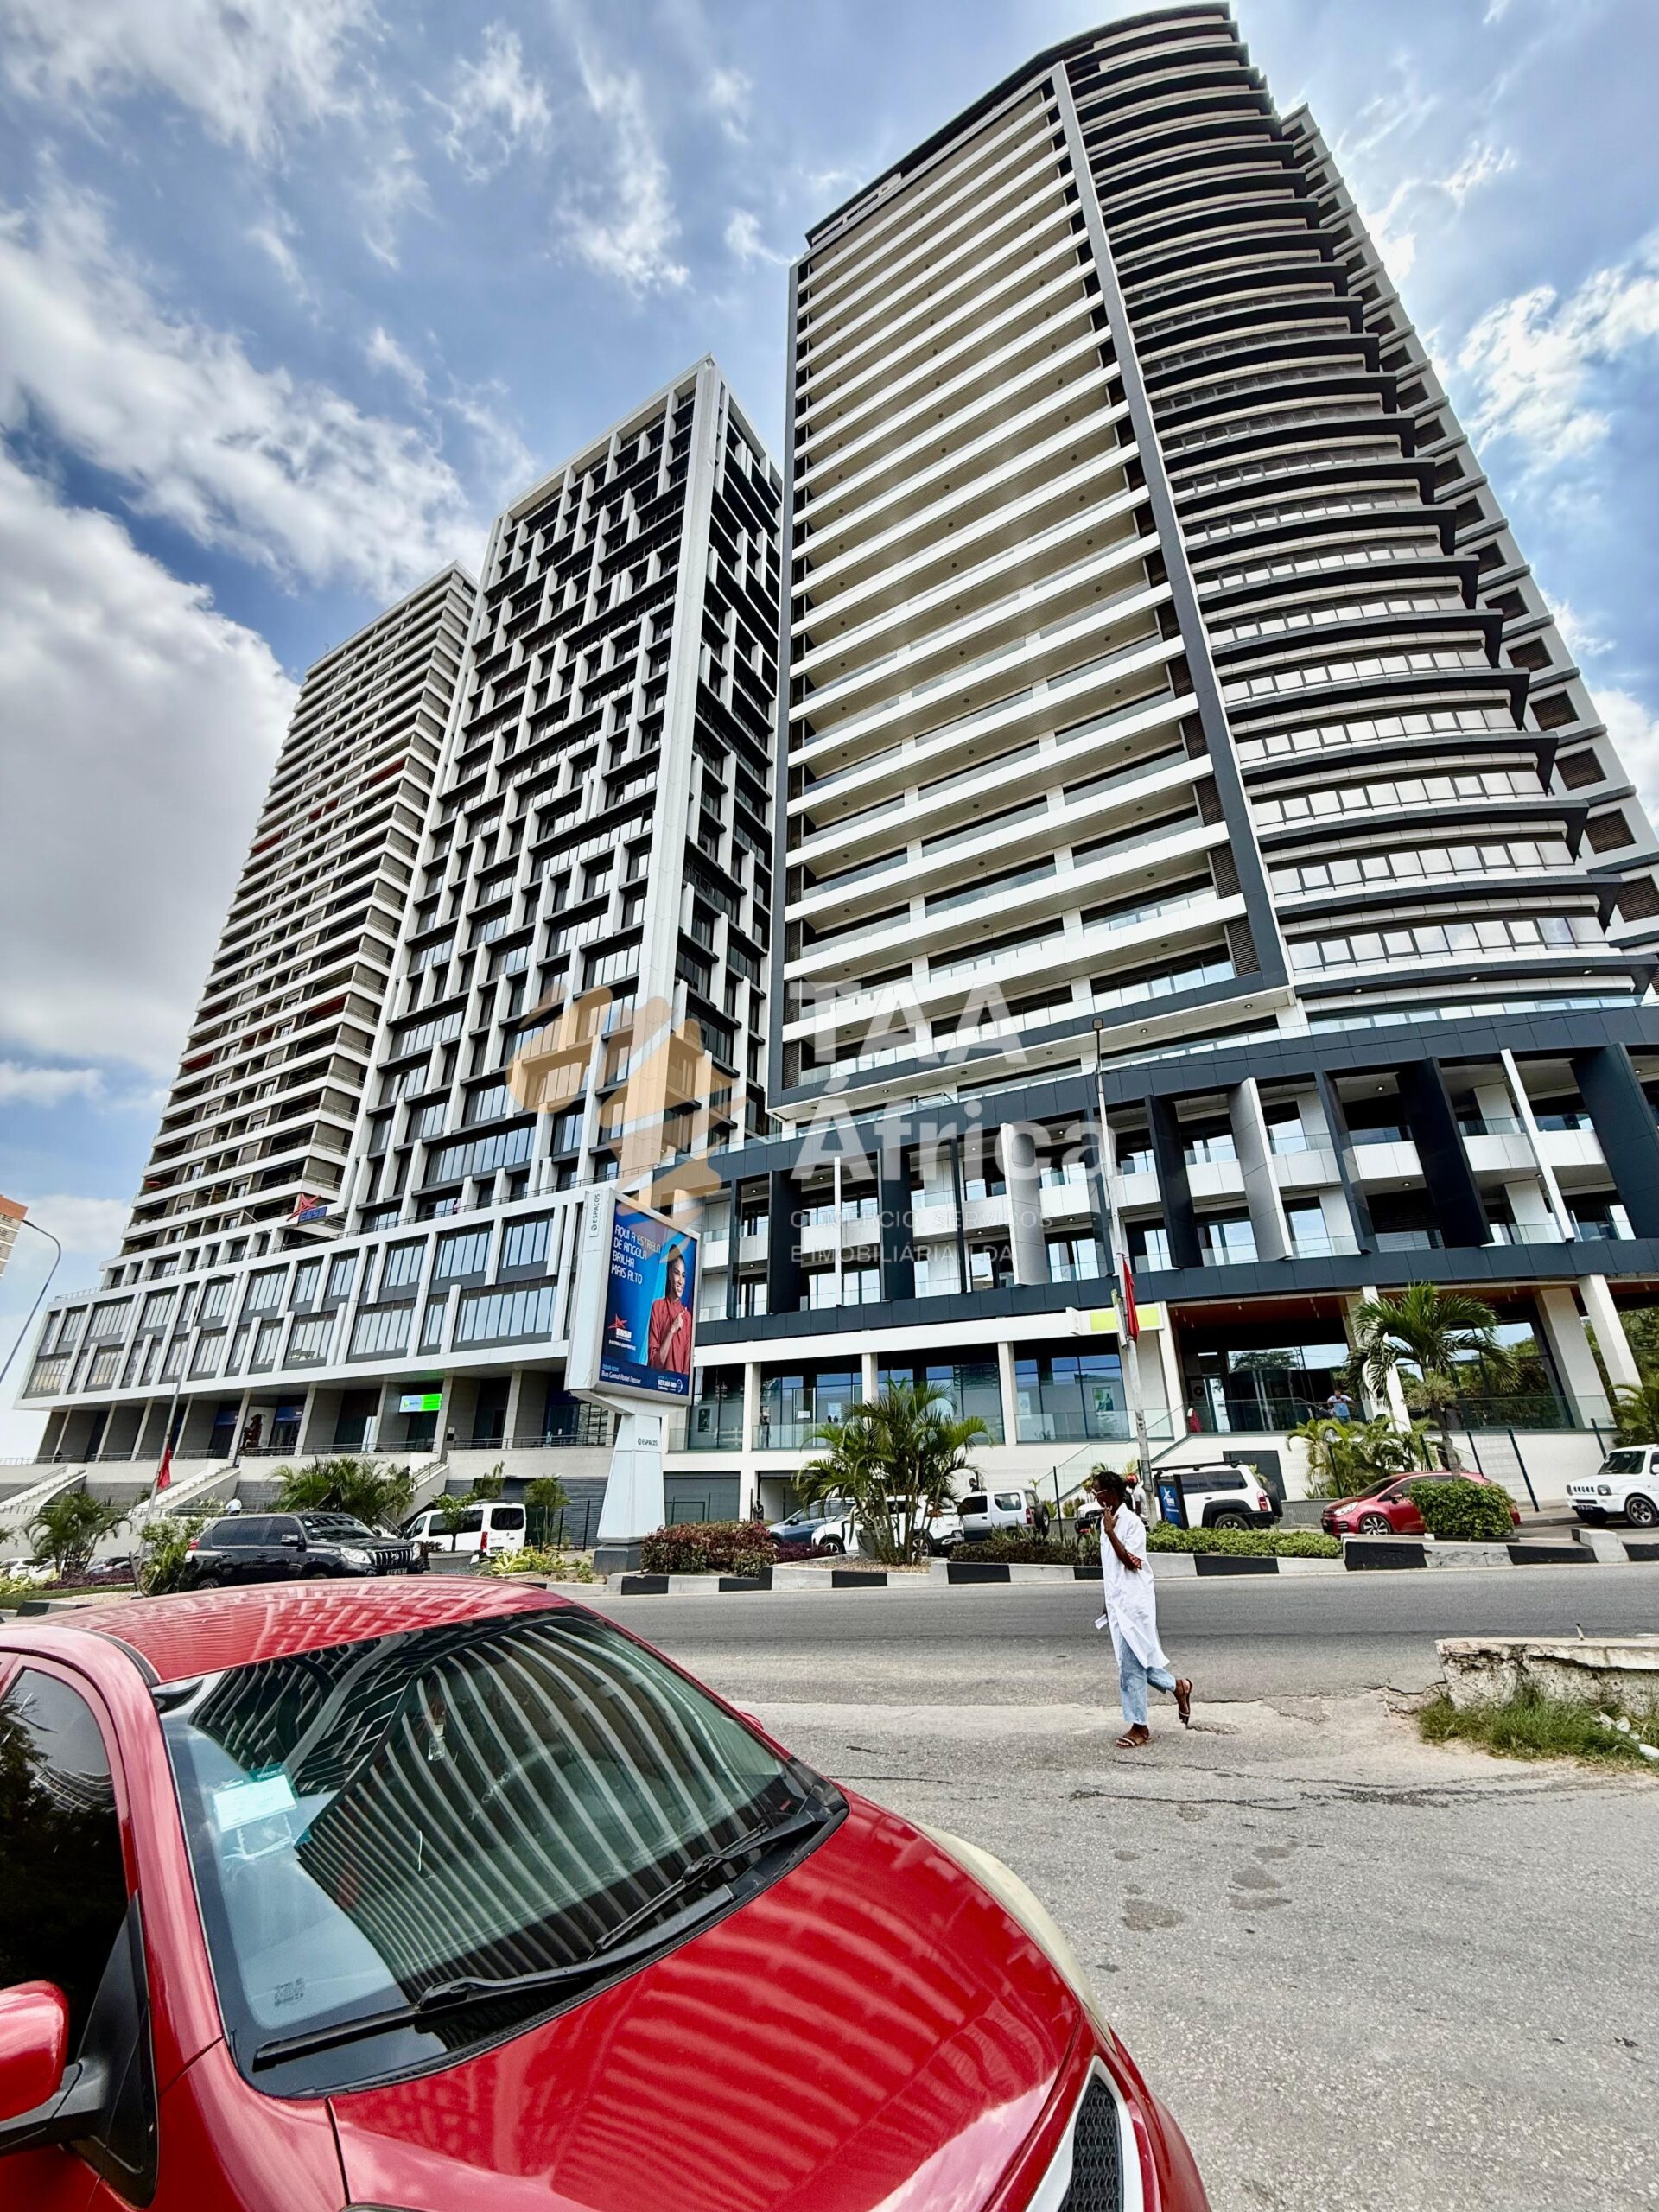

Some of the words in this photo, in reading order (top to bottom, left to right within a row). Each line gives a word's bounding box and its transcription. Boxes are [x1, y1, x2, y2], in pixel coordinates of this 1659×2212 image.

[613, 1236, 623, 1249] DE
[623, 1242, 647, 1261] ANGOLA
[614, 1224, 630, 1240] AQUI
[631, 1232, 636, 1243] A
[637, 1235, 661, 1254] ESTRELA
[612, 1249, 635, 1268] BRILHA
[611, 1263, 626, 1278] MAIS
[627, 1269, 643, 1285] ALTO
